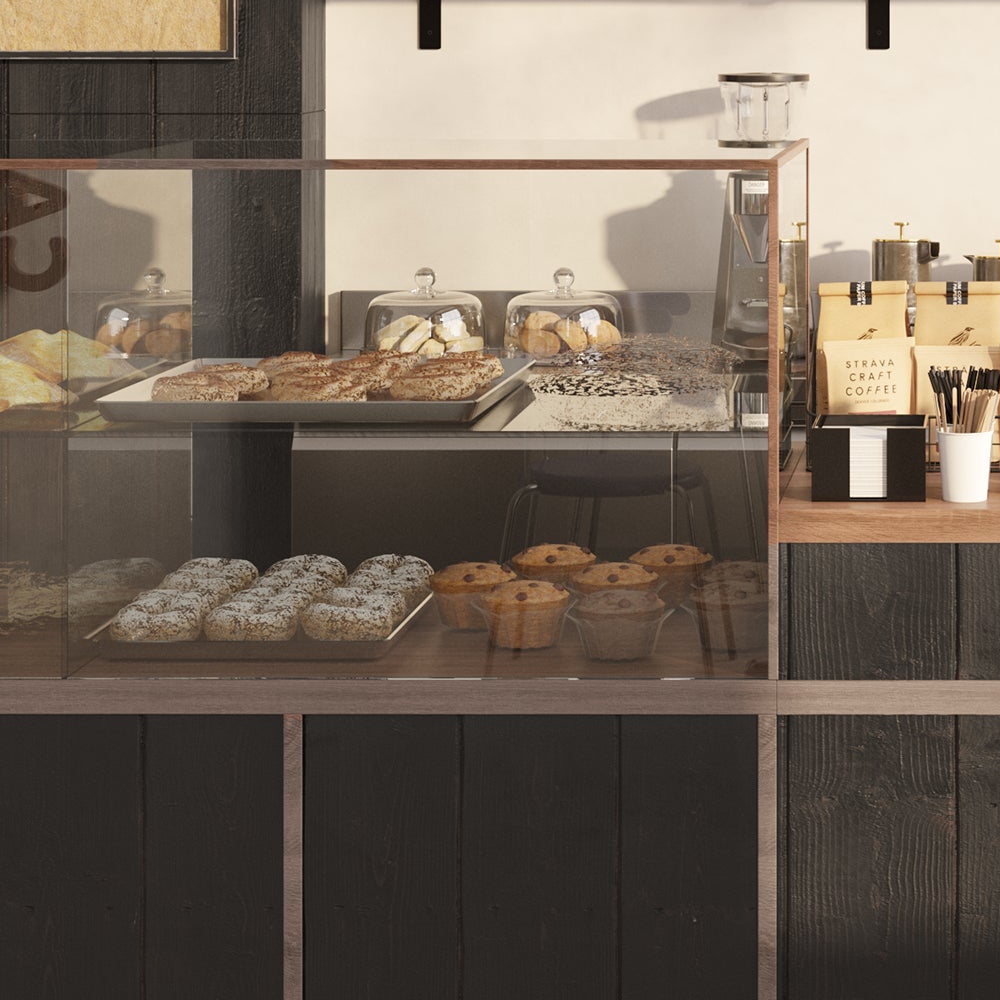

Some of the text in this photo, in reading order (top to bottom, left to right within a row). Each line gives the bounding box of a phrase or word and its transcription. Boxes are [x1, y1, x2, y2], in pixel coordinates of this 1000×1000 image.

[846, 359, 894, 368] STRAVA
[850, 373, 892, 381] CRAFT
[846, 385, 896, 396] COFFEE
